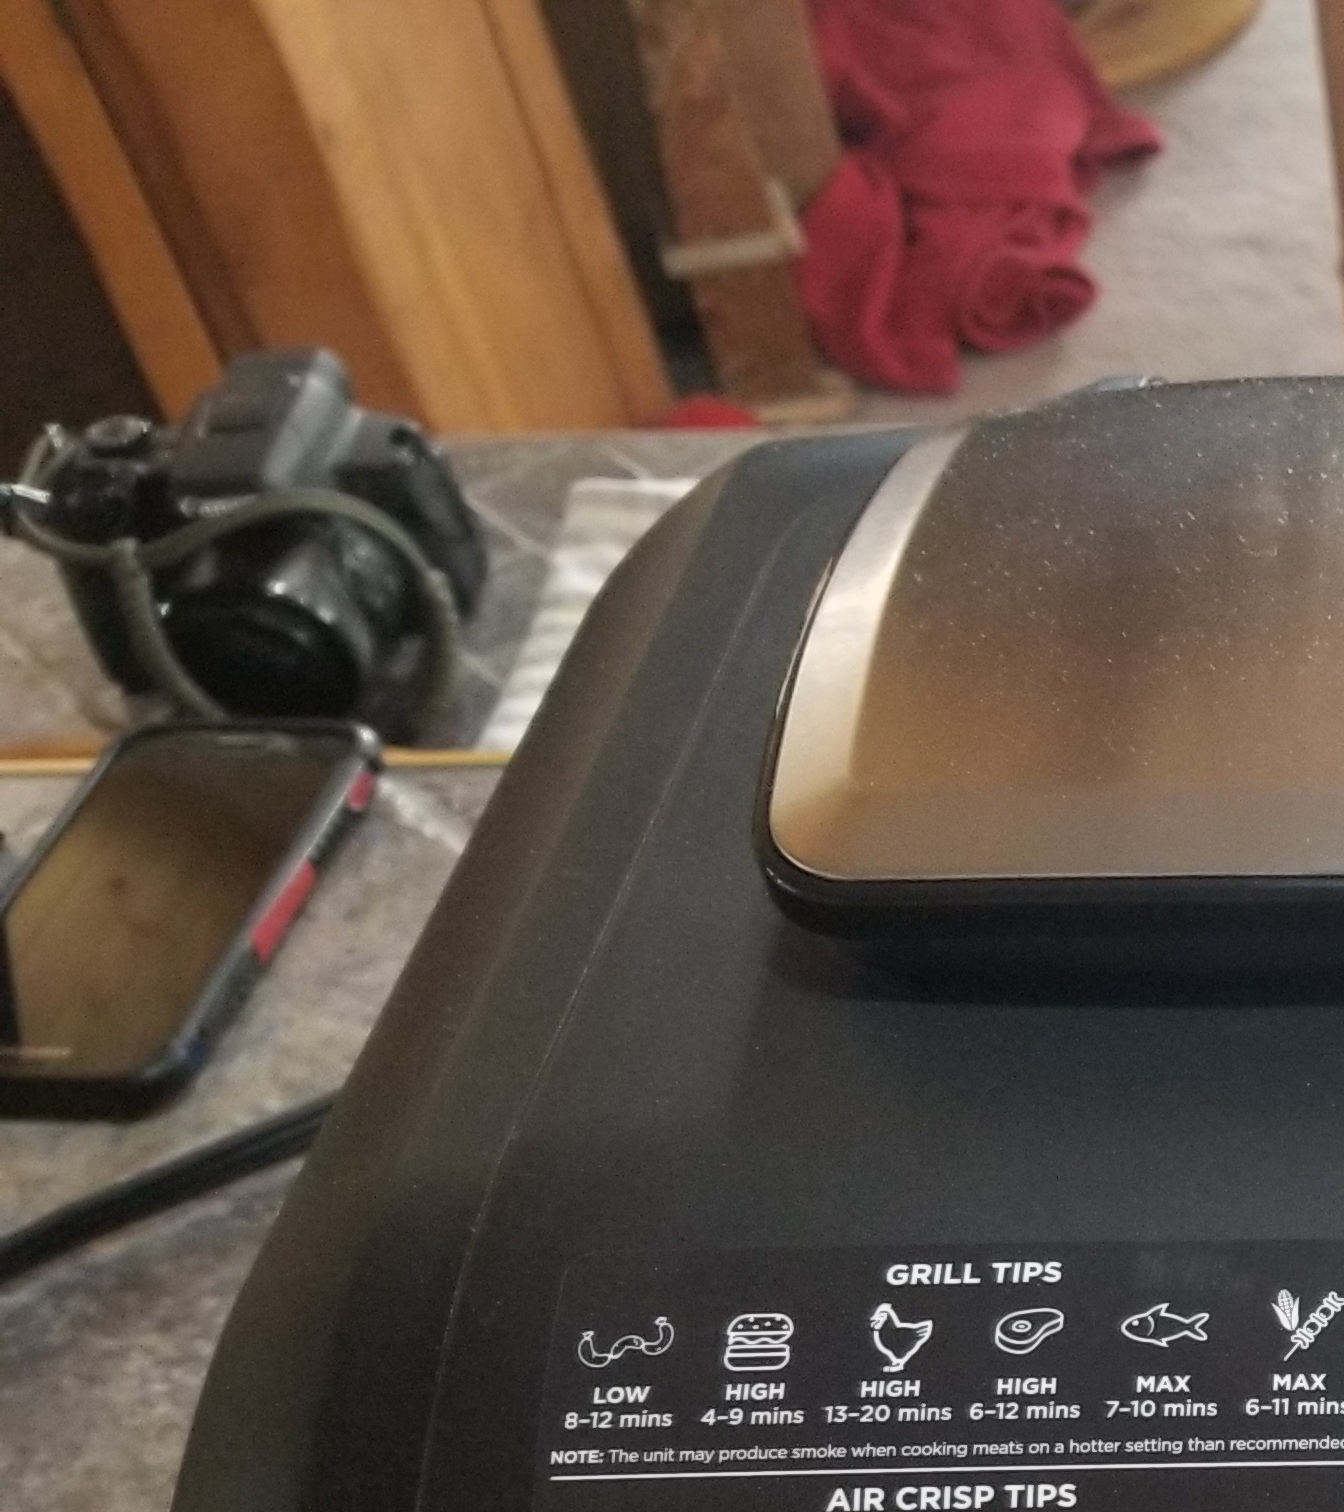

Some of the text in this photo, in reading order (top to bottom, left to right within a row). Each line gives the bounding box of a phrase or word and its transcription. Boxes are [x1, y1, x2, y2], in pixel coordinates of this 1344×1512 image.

[886, 1261, 1062, 1286] GRILL TIPS
[725, 1382, 785, 1401] HIGH
[860, 1379, 921, 1398] HIGH
[996, 1377, 1057, 1395] HIGH
[1136, 1375, 1191, 1393] MAX
[1272, 1373, 1327, 1391] MAX
[593, 1385, 651, 1404] LOW
[700, 1406, 805, 1426] 4-9 mins
[824, 1403, 952, 1424] 13-20 mins
[969, 1400, 1081, 1421] 6-12 mins
[1105, 1398, 1218, 1418] 7-10 mins
[1245, 1397, 1290, 1416] 6-11
[564, 1409, 673, 1430] 8-12 mins
[550, 1449, 605, 1465] NOTE:
[608, 1448, 640, 1463] The
[643, 1447, 675, 1462] unit
[678, 1449, 716, 1464] may
[718, 1445, 789, 1463] produce
[791, 1443, 848, 1459] smoke
[850, 1442, 897, 1458] when
[901, 1441, 968, 1458] cooking
[972, 1440, 1024, 1455] meats
[1028, 1442, 1050, 1454] on
[1053, 1442, 1065, 1454] a
[1069, 1438, 1122, 1454] hotter
[1124, 1437, 1184, 1455] setting
[1187, 1436, 1225, 1452] than
[826, 1483, 1077, 1512] AIR CRISP TIPS
